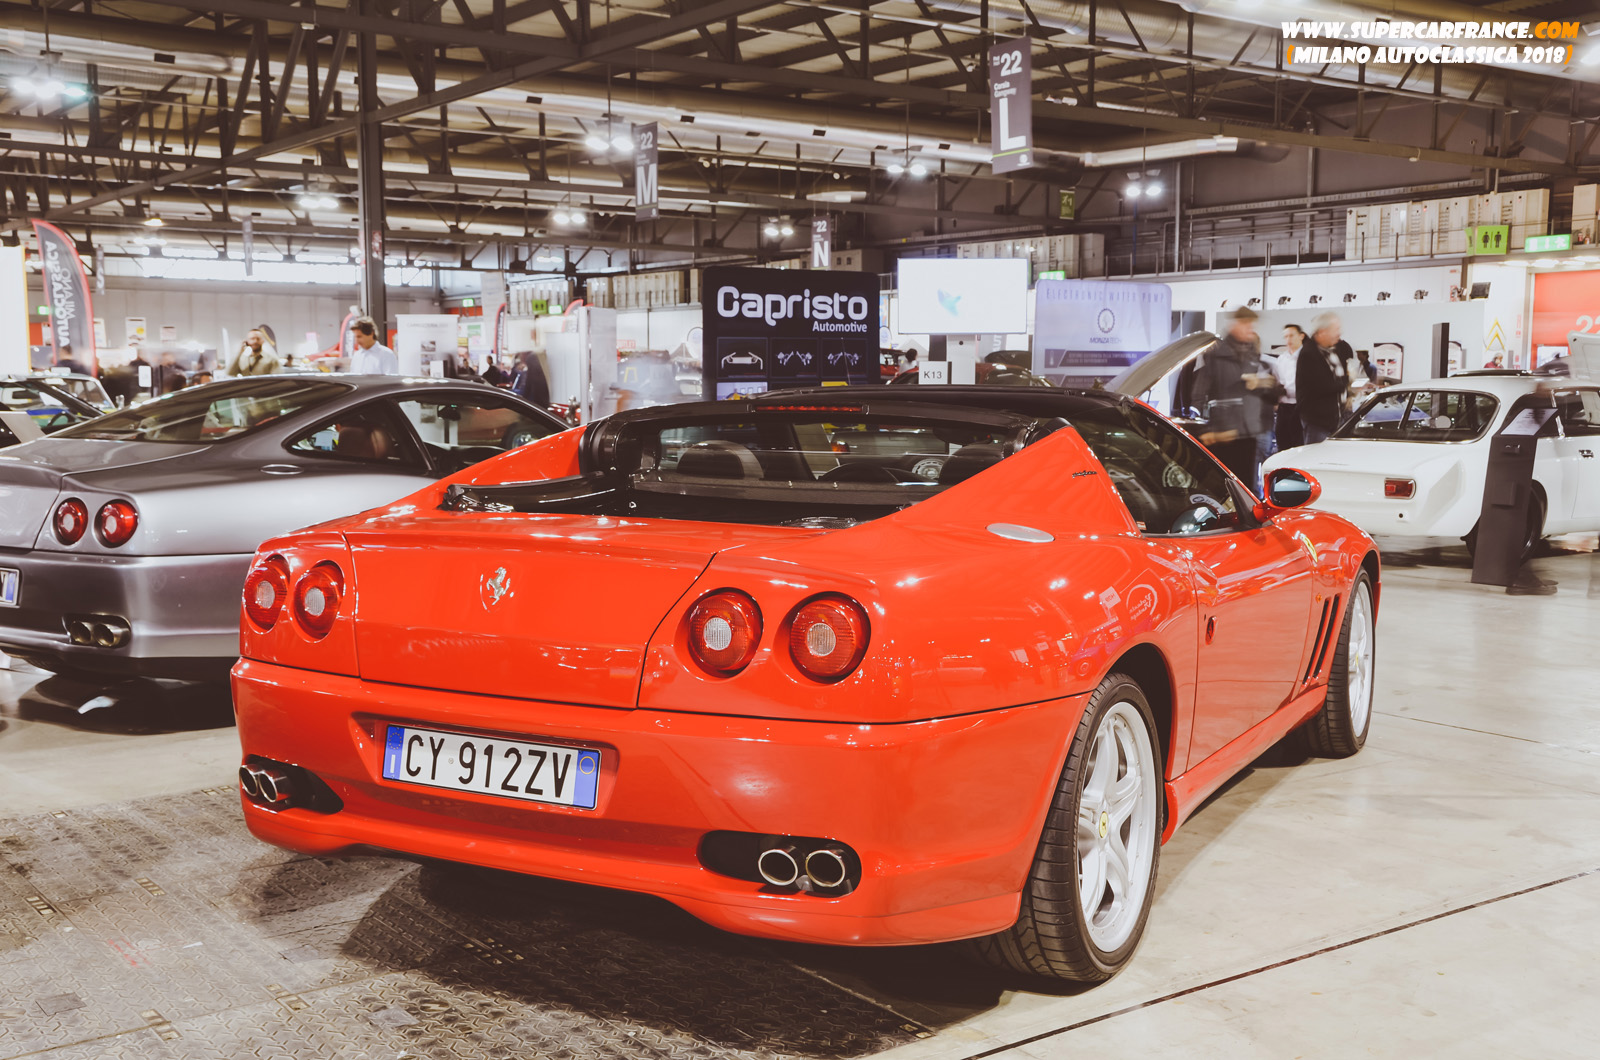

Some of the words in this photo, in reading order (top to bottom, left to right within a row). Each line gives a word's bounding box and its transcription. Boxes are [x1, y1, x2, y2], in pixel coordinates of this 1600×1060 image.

[1000, 50, 1022, 77] 22
[999, 97, 1026, 151] L
[640, 131, 653, 150] 22
[636, 163, 657, 205] M
[816, 220, 827, 232] 22
[814, 240, 829, 267] N
[717, 286, 868, 326] Capristo
[812, 321, 867, 332] Automotive
[923, 371, 942, 379] K13
[406, 734, 445, 780] CY
[458, 741, 572, 798] 912ZV
